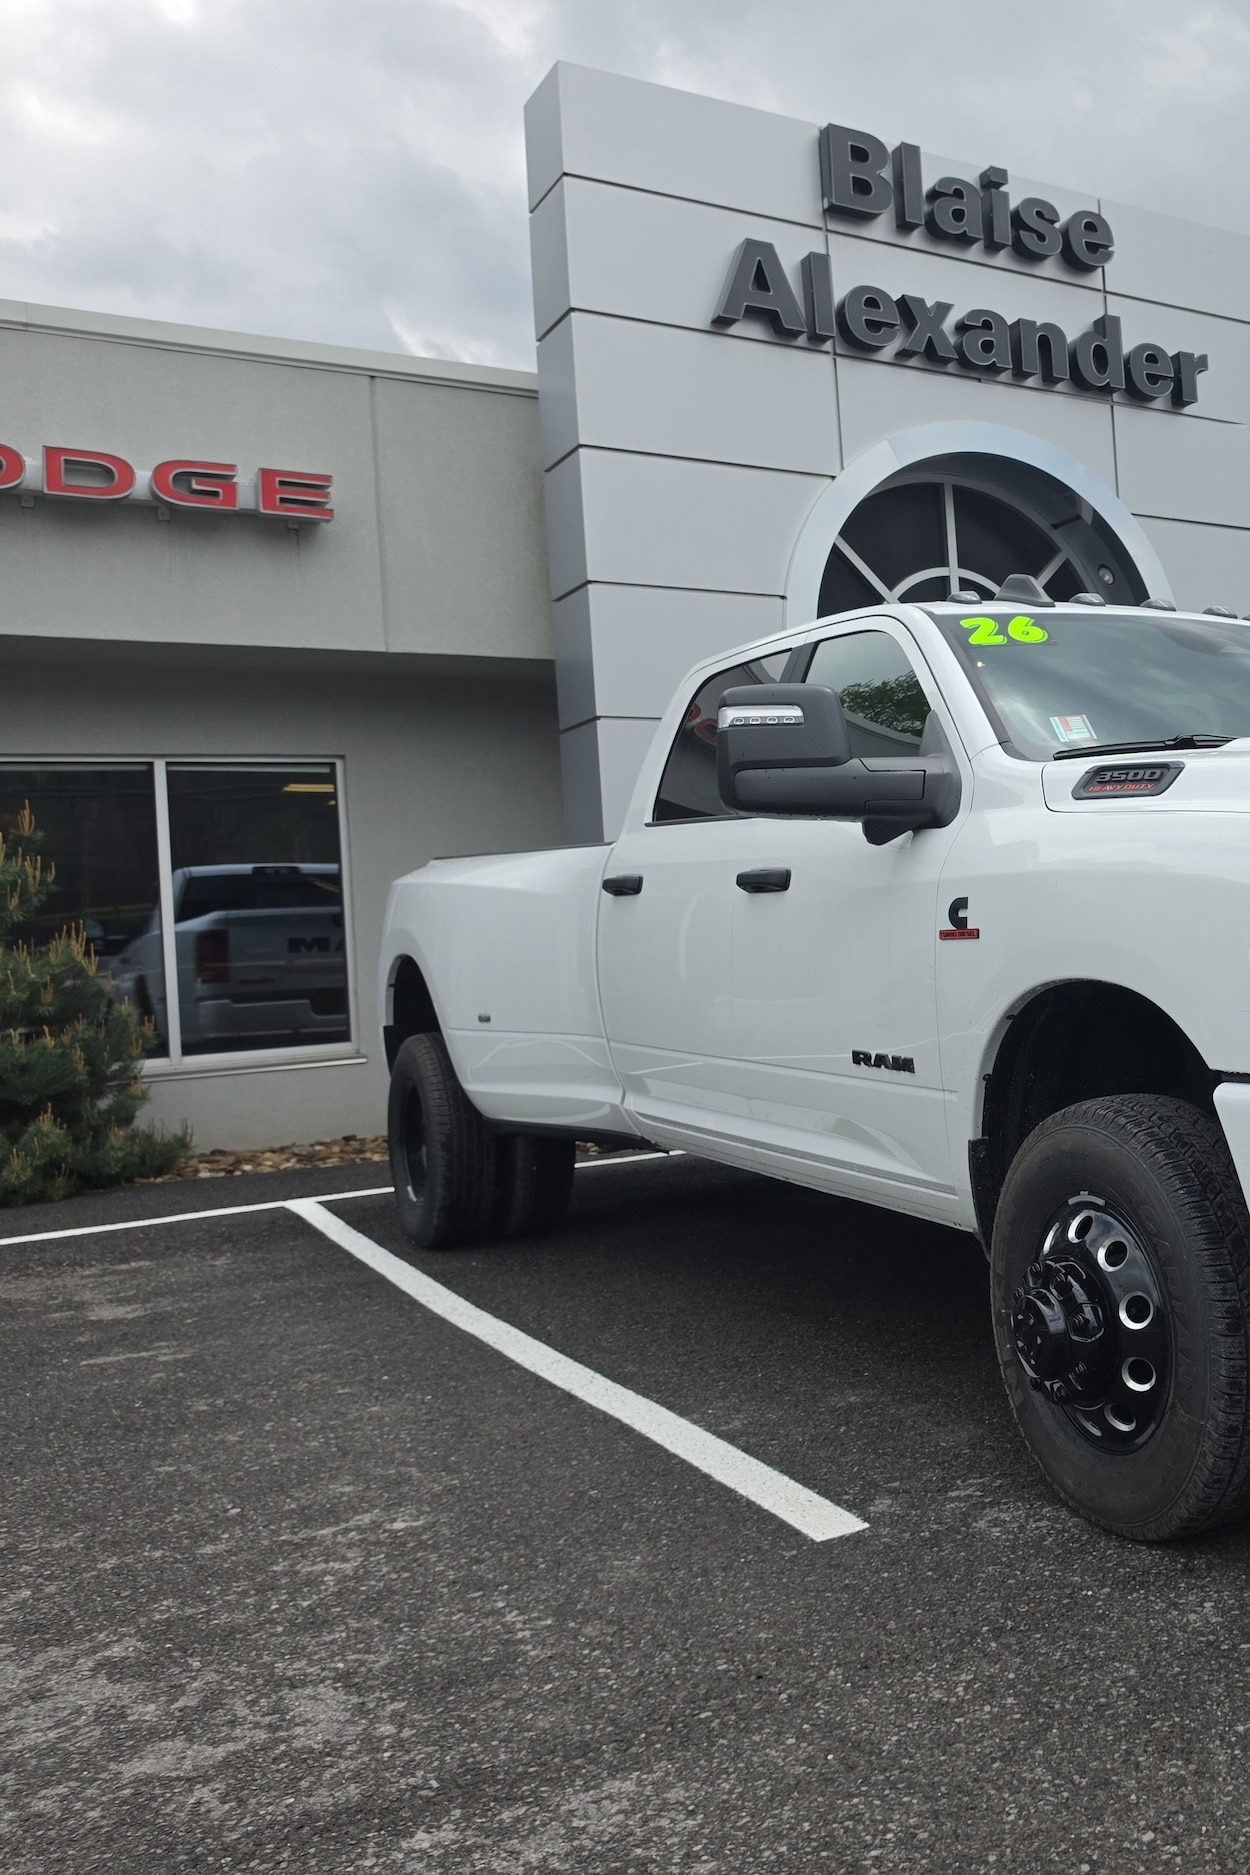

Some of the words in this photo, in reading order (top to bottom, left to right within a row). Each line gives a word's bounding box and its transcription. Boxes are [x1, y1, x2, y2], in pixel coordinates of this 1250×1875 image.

[819, 123, 1115, 272] Blaise
[711, 238, 1208, 407] Alexander
[0, 443, 334, 523] DGE
[960, 616, 1048, 645] 26
[1088, 784, 1123, 792] HEAVY
[1096, 769, 1162, 784] 3500
[852, 1050, 915, 1074] RAM
